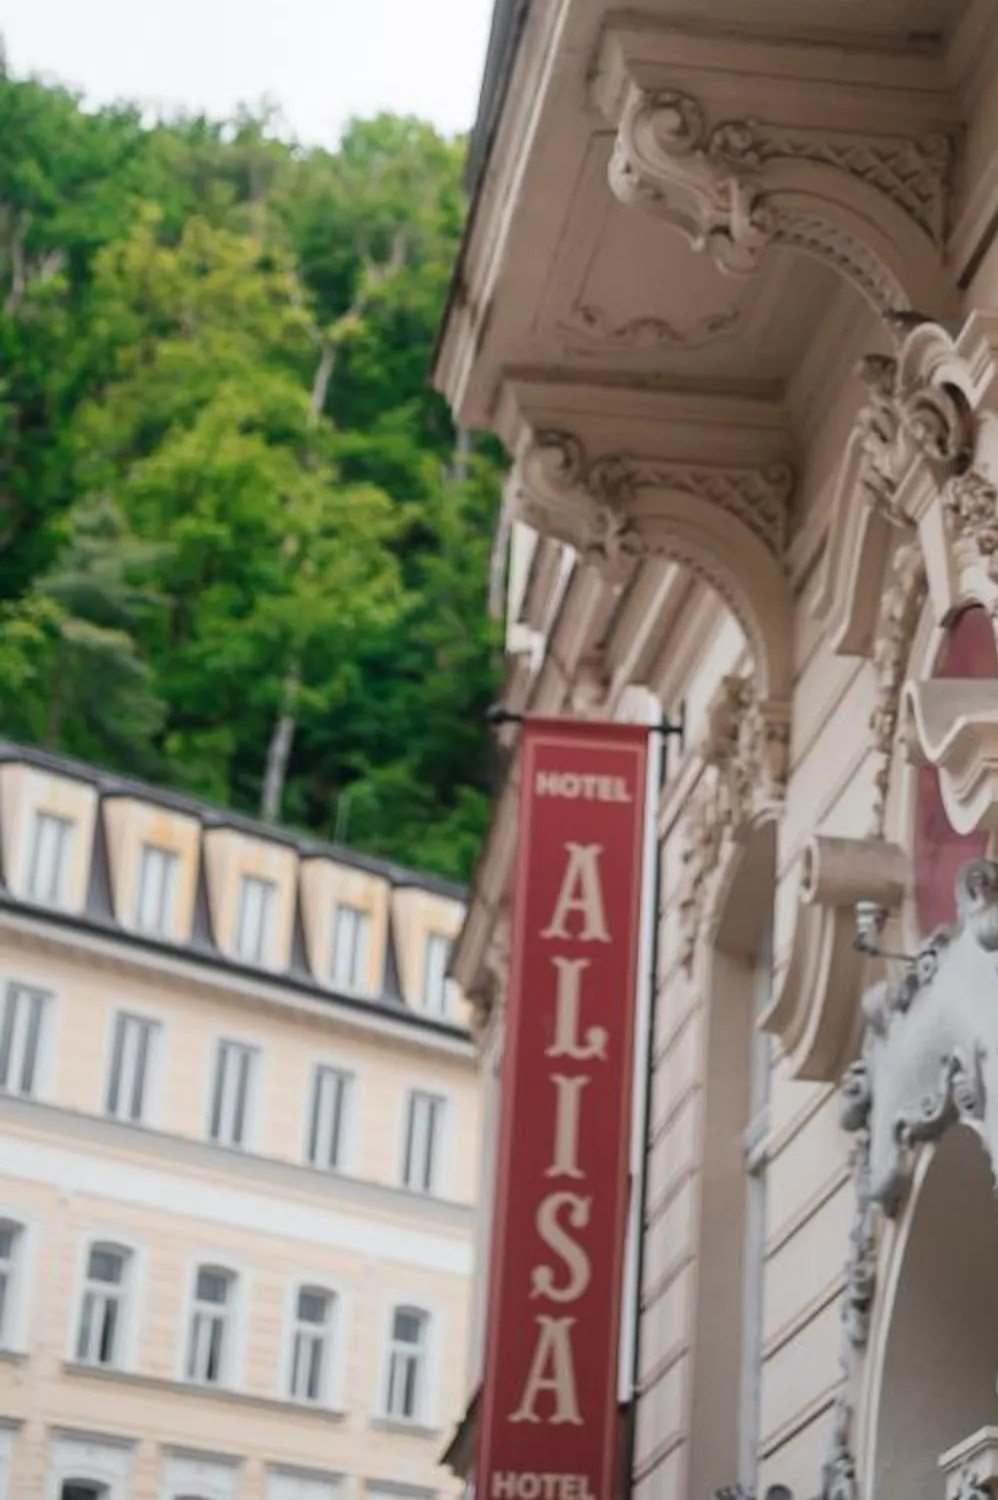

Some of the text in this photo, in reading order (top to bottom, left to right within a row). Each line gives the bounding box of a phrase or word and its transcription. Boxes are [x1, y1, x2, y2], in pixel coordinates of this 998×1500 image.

[536, 770, 632, 802] HOTEL
[508, 841, 611, 1425] ALISA
[492, 1471, 596, 1500] HOTEL
